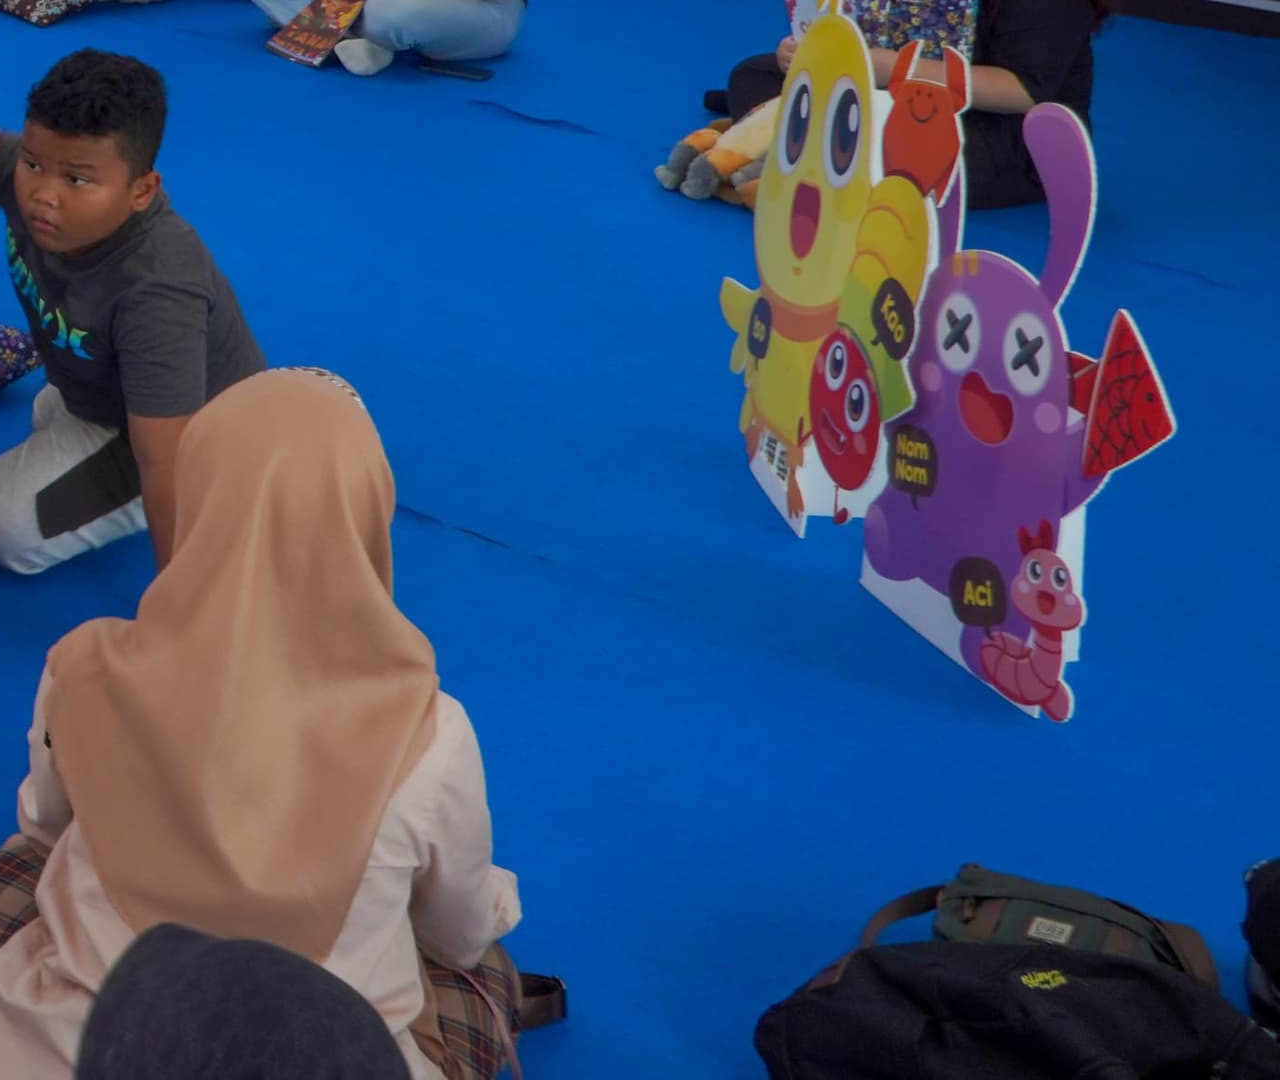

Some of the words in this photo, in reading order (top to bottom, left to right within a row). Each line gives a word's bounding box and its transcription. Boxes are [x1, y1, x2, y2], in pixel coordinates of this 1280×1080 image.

[896, 434, 929, 461] Nom
[895, 460, 928, 486] Nom
[963, 580, 994, 607] Aci
